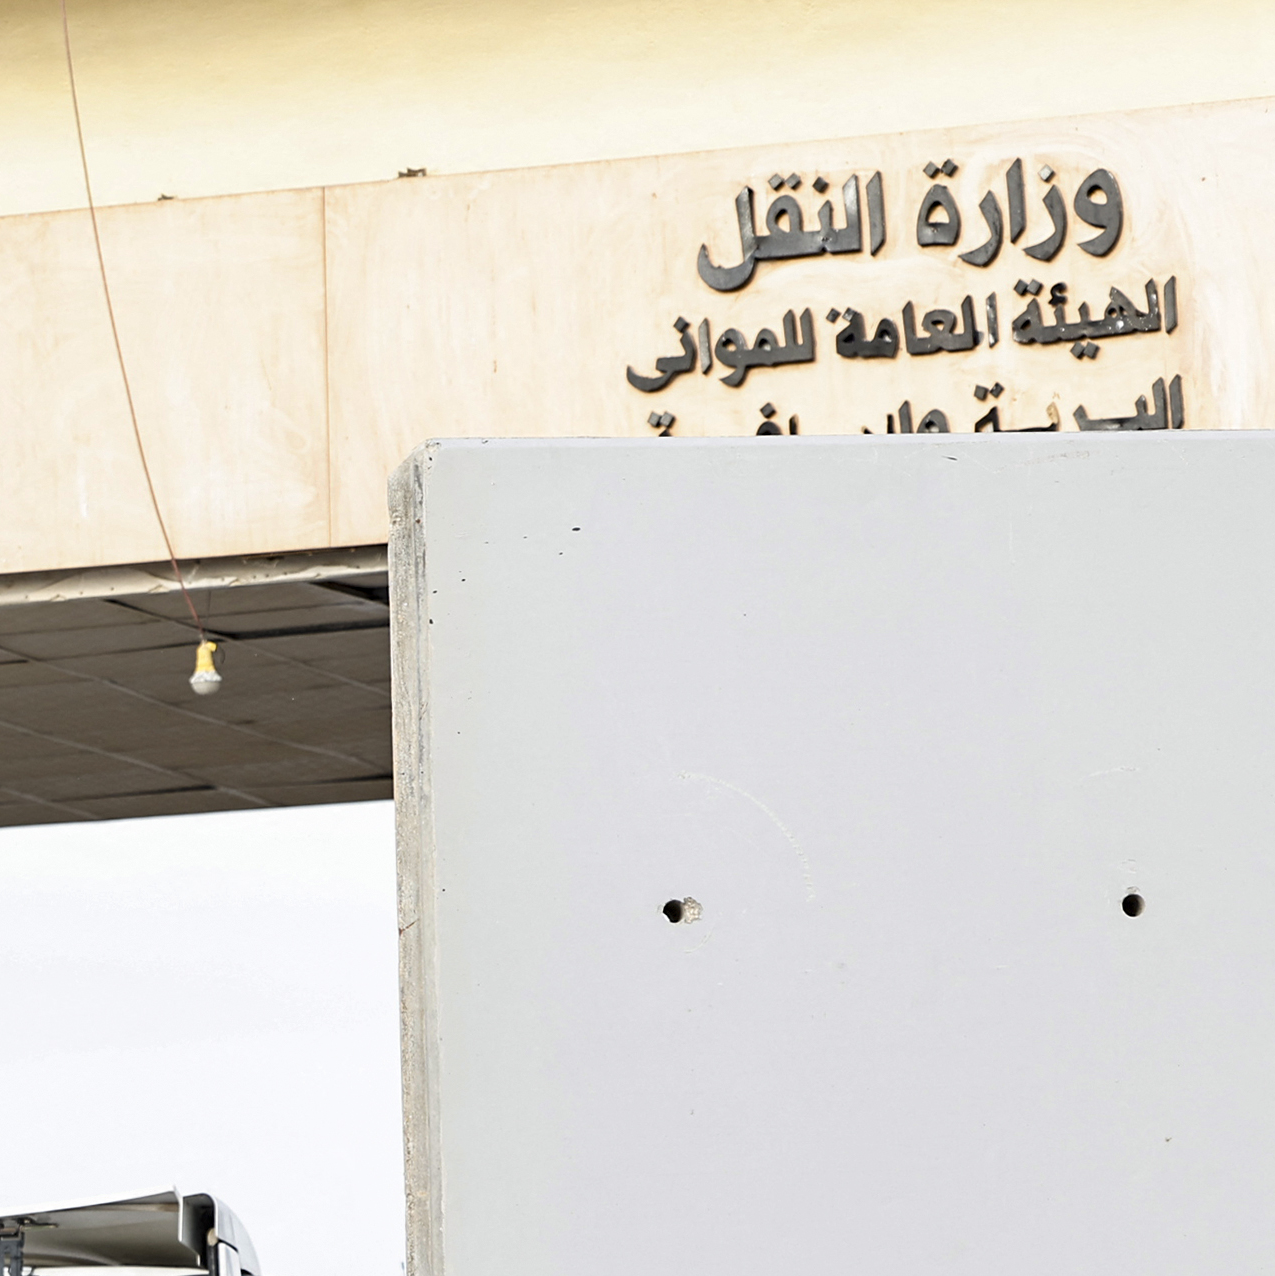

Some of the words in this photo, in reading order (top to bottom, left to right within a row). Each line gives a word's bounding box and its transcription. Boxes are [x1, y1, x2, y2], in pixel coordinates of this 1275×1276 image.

[696, 170, 887, 294] النقل
[916, 157, 1124, 269] وزارة
[826, 292, 1001, 361] العامة
[1011, 276, 1179, 360] الهيئة
